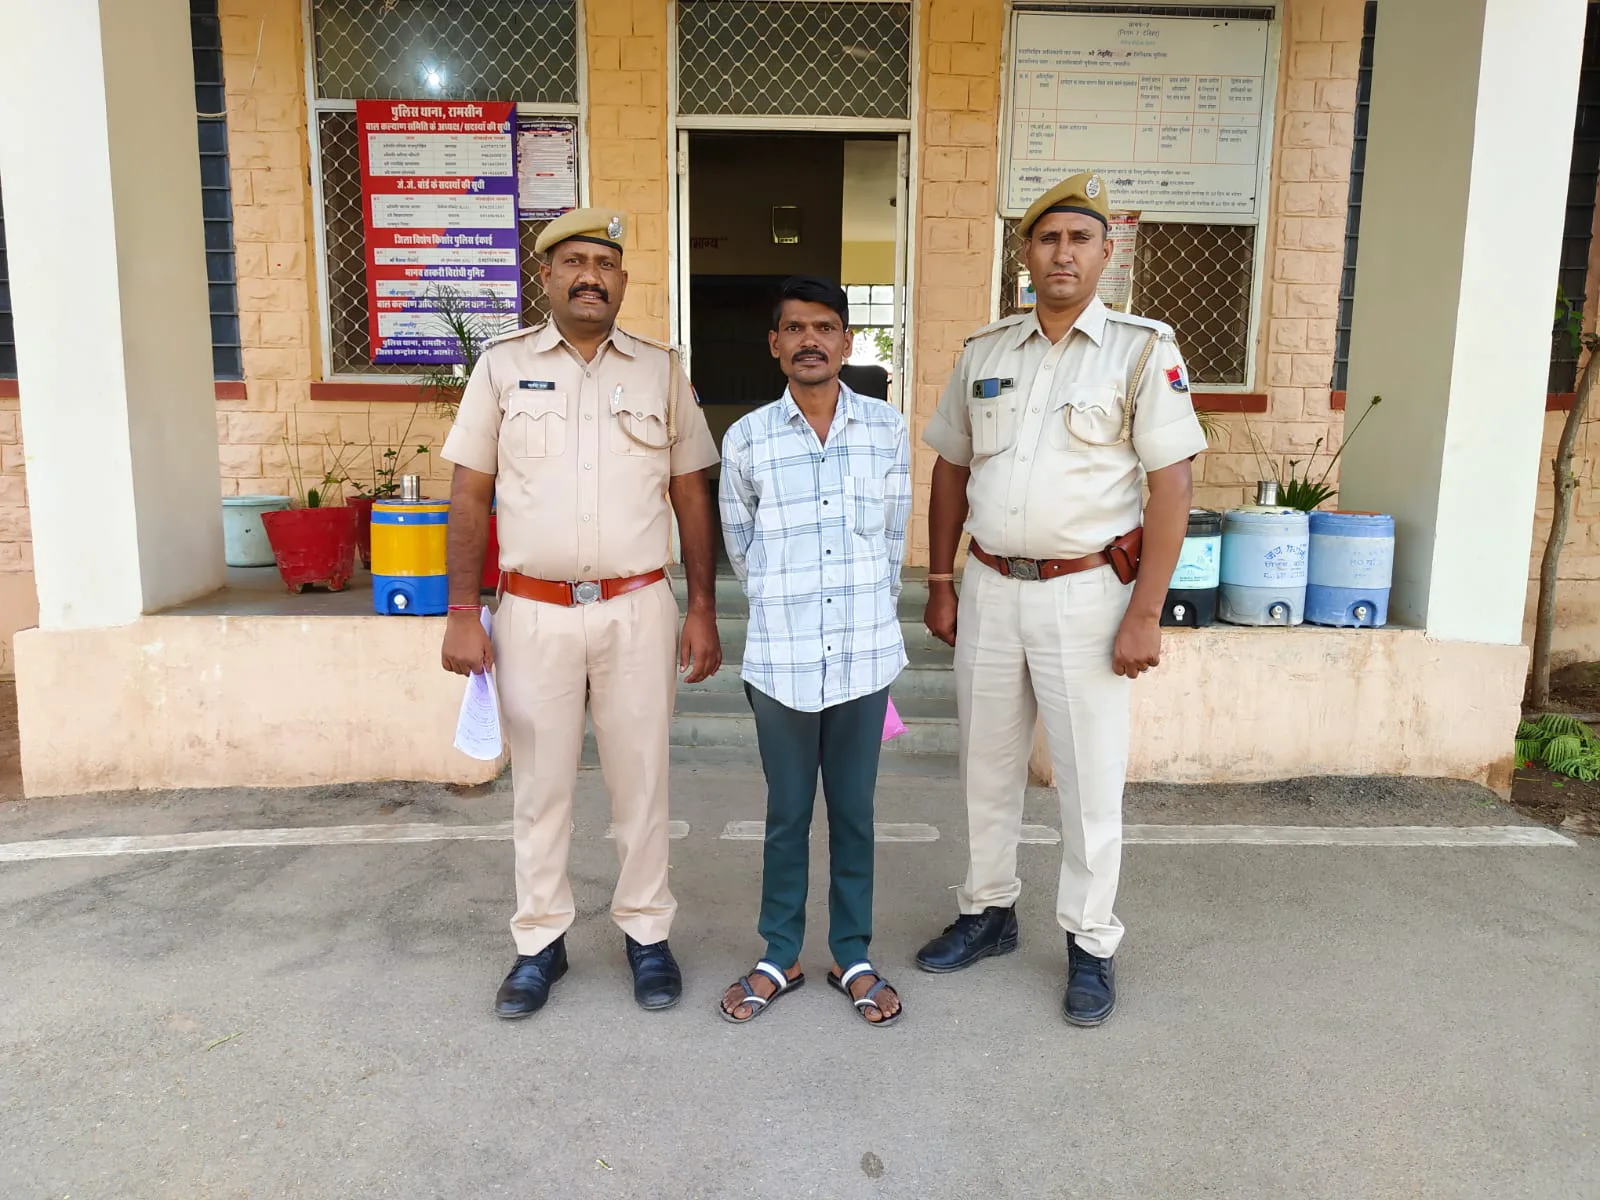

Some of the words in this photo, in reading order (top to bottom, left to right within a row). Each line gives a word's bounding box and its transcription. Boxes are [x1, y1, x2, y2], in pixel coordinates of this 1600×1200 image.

[391, 103, 419, 121] पुलिस
[447, 104, 483, 118] रामसीन
[394, 233, 413, 245] जिला
[454, 233, 474, 247] पुलिस
[382, 338, 402, 348] पुलिस
